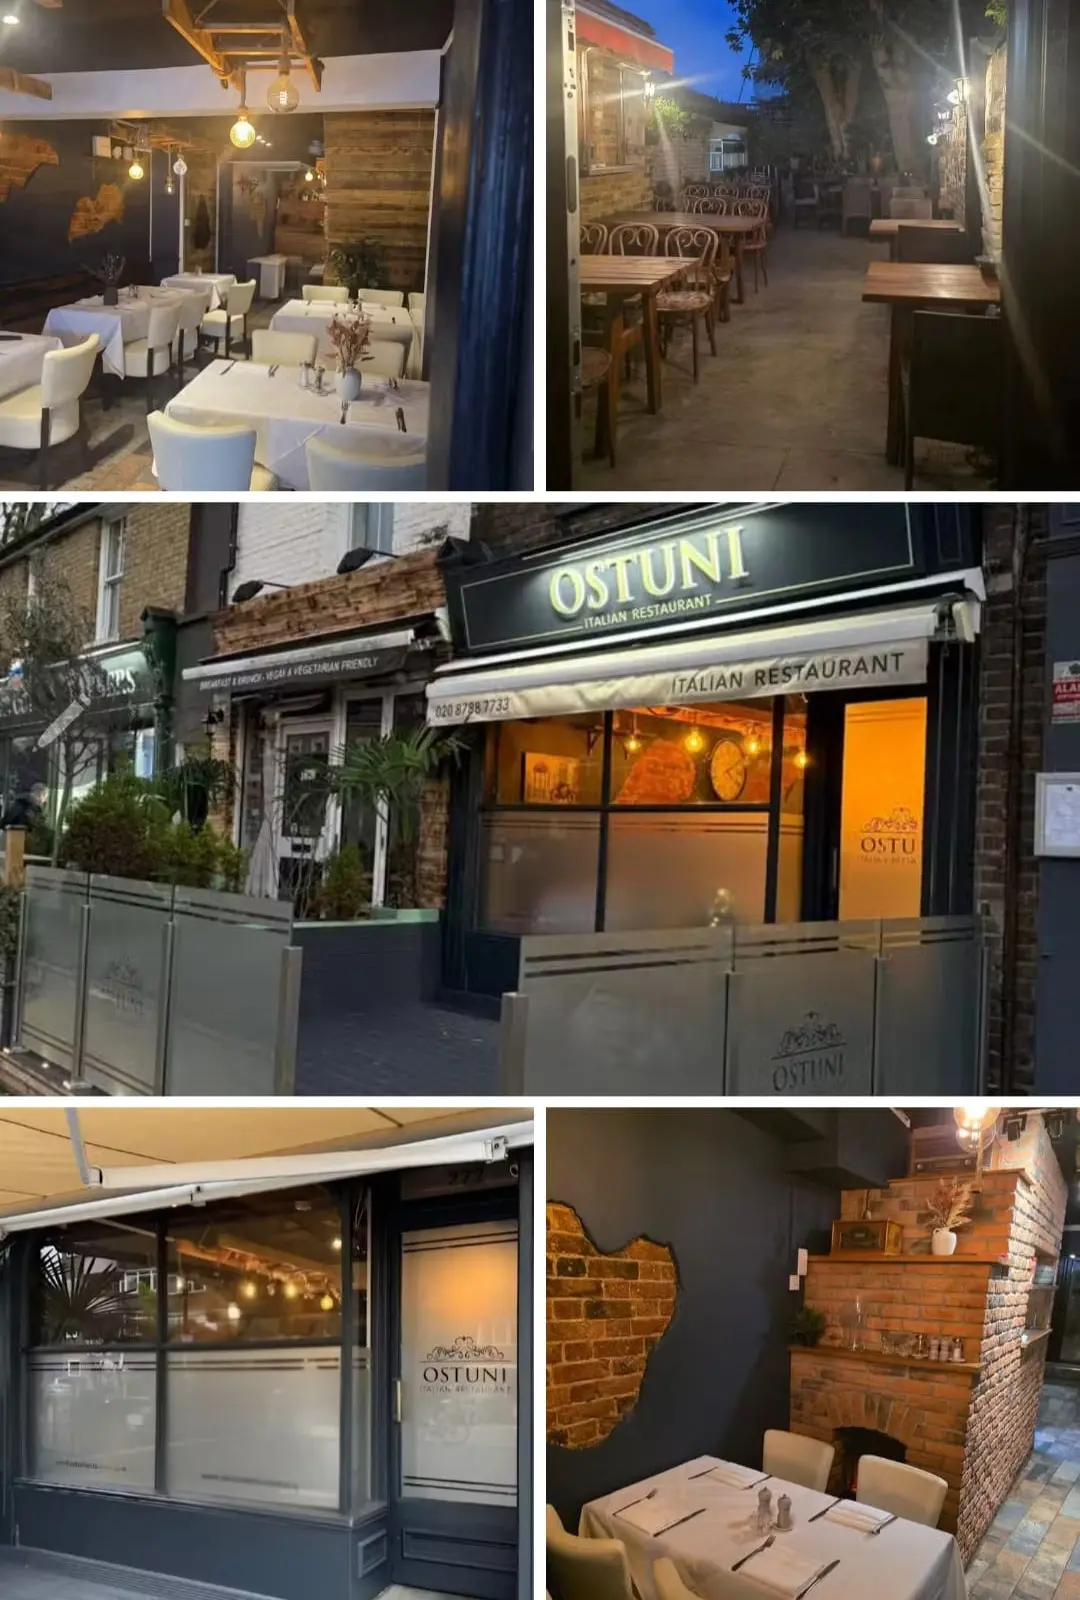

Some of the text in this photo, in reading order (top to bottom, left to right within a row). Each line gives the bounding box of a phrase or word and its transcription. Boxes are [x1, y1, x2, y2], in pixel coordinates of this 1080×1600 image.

[550, 525, 749, 615] OSTUNI
[584, 593, 713, 629] ITALIAN RESTAURANT
[294, 660, 340, 676] VEGETARIAN
[341, 656, 379, 672] FRIENDLY
[671, 652, 904, 694] ITALIAN RESTAURANT
[435, 703, 453, 717] 020
[483, 697, 510, 713] 7733
[861, 837, 915, 854] OSTU
[773, 1053, 843, 1092] OSTUNI
[423, 1366, 506, 1383] OSTUNI
